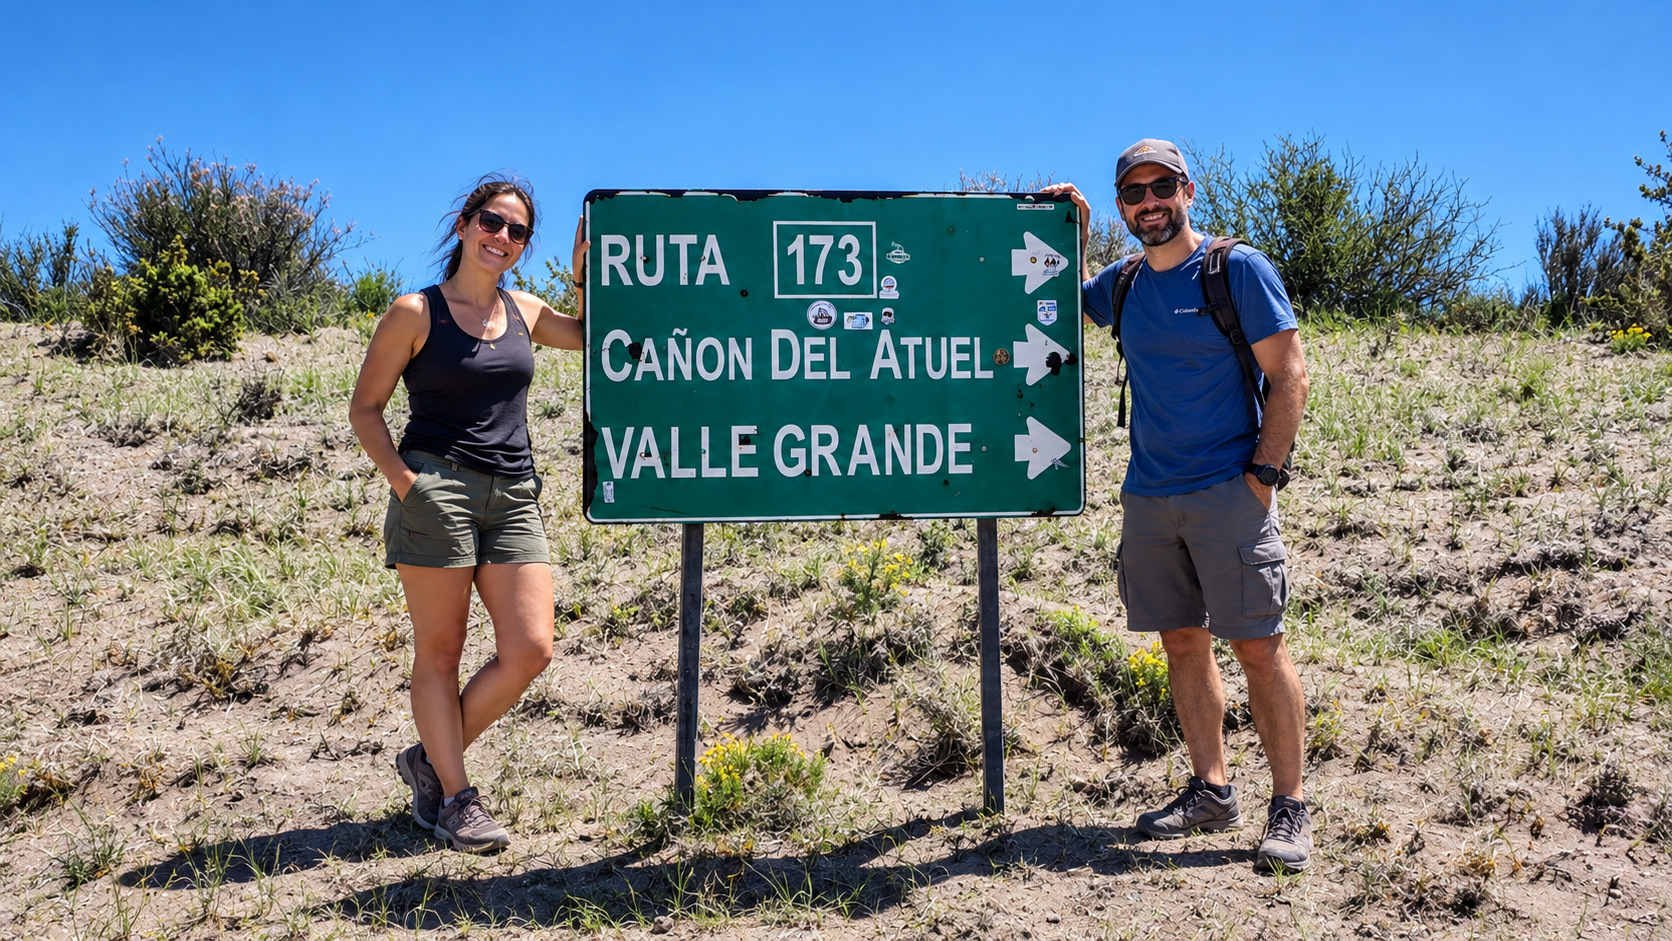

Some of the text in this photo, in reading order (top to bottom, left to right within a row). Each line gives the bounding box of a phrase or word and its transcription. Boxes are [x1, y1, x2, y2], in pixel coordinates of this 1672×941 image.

[601, 234, 862, 286] RUTA 173
[602, 328, 994, 381] CAÑON DEL ATUEL
[602, 424, 973, 478] VALLE GRANDE
